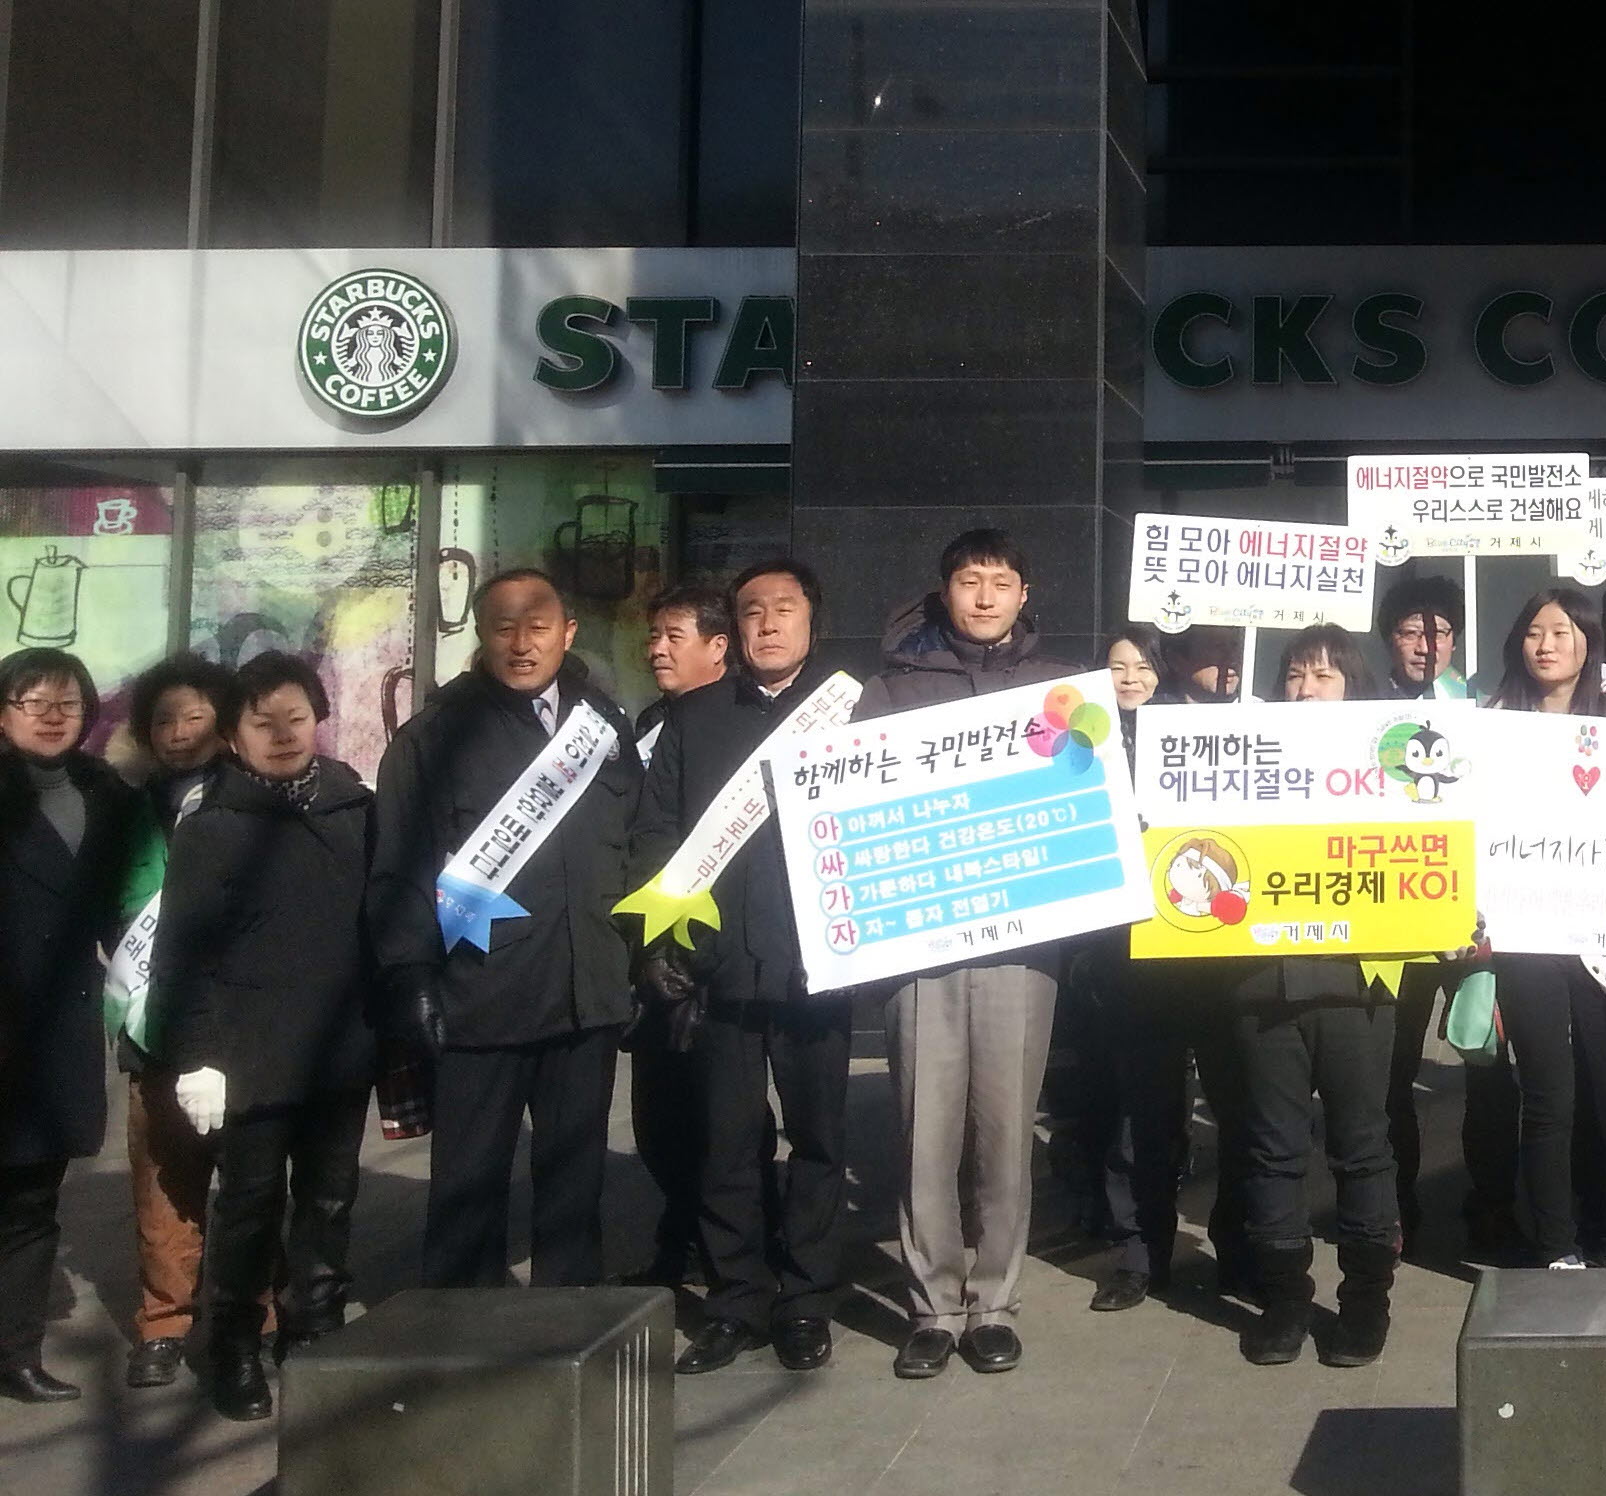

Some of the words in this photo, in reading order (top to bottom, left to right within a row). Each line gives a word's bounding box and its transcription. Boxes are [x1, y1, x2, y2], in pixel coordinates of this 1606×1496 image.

[311, 279, 440, 342] STARBUCKS
[325, 368, 428, 407] COFFEE
[1356, 466, 1484, 490] 에너지절약으로
[1491, 465, 1582, 489] 국민발전소
[1413, 499, 1503, 523] 우리스스로
[1510, 497, 1583, 523] 건설해요
[1146, 524, 1169, 552] 힘
[1179, 526, 1231, 555] 모아
[1239, 530, 1368, 563] 에너지절약
[1144, 556, 1168, 584] 뜻
[1177, 558, 1228, 587] 모아
[1237, 561, 1364, 594] 에너지실천
[793, 747, 901, 800] 함께하는
[916, 717, 1046, 773] 국민발전소
[1160, 733, 1283, 768] 함께하는
[1158, 767, 1315, 802] 에너지절약
[1325, 766, 1386, 798] OK!
[813, 815, 839, 841] 아
[912, 791, 971, 819] 나누자
[686, 798, 766, 894] 바로지금!
[820, 851, 845, 877] 싸
[1327, 834, 1449, 868] 마구쓰면
[825, 886, 851, 911] 가
[1261, 870, 1386, 906] 우리경제
[1399, 869, 1459, 902] KO!
[831, 919, 857, 945] 자
